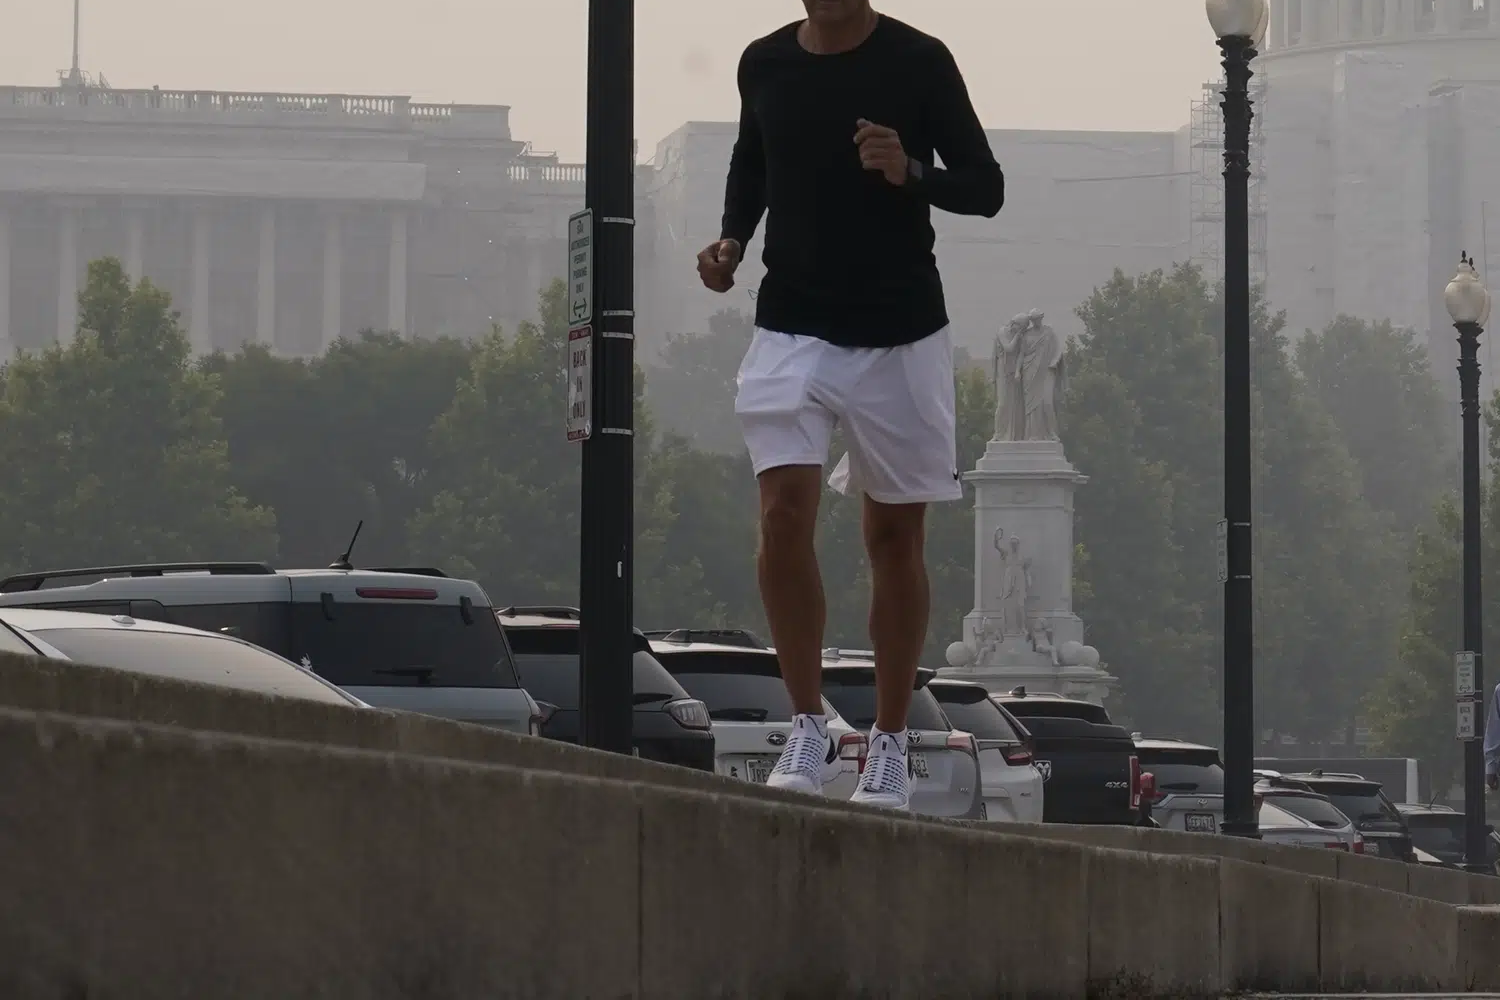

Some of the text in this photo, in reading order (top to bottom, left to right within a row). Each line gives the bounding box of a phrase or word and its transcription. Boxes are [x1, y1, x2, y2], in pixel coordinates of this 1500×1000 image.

[573, 350, 587, 368] BACK
[576, 376, 583, 392] IN
[573, 400, 586, 419] ONLY
